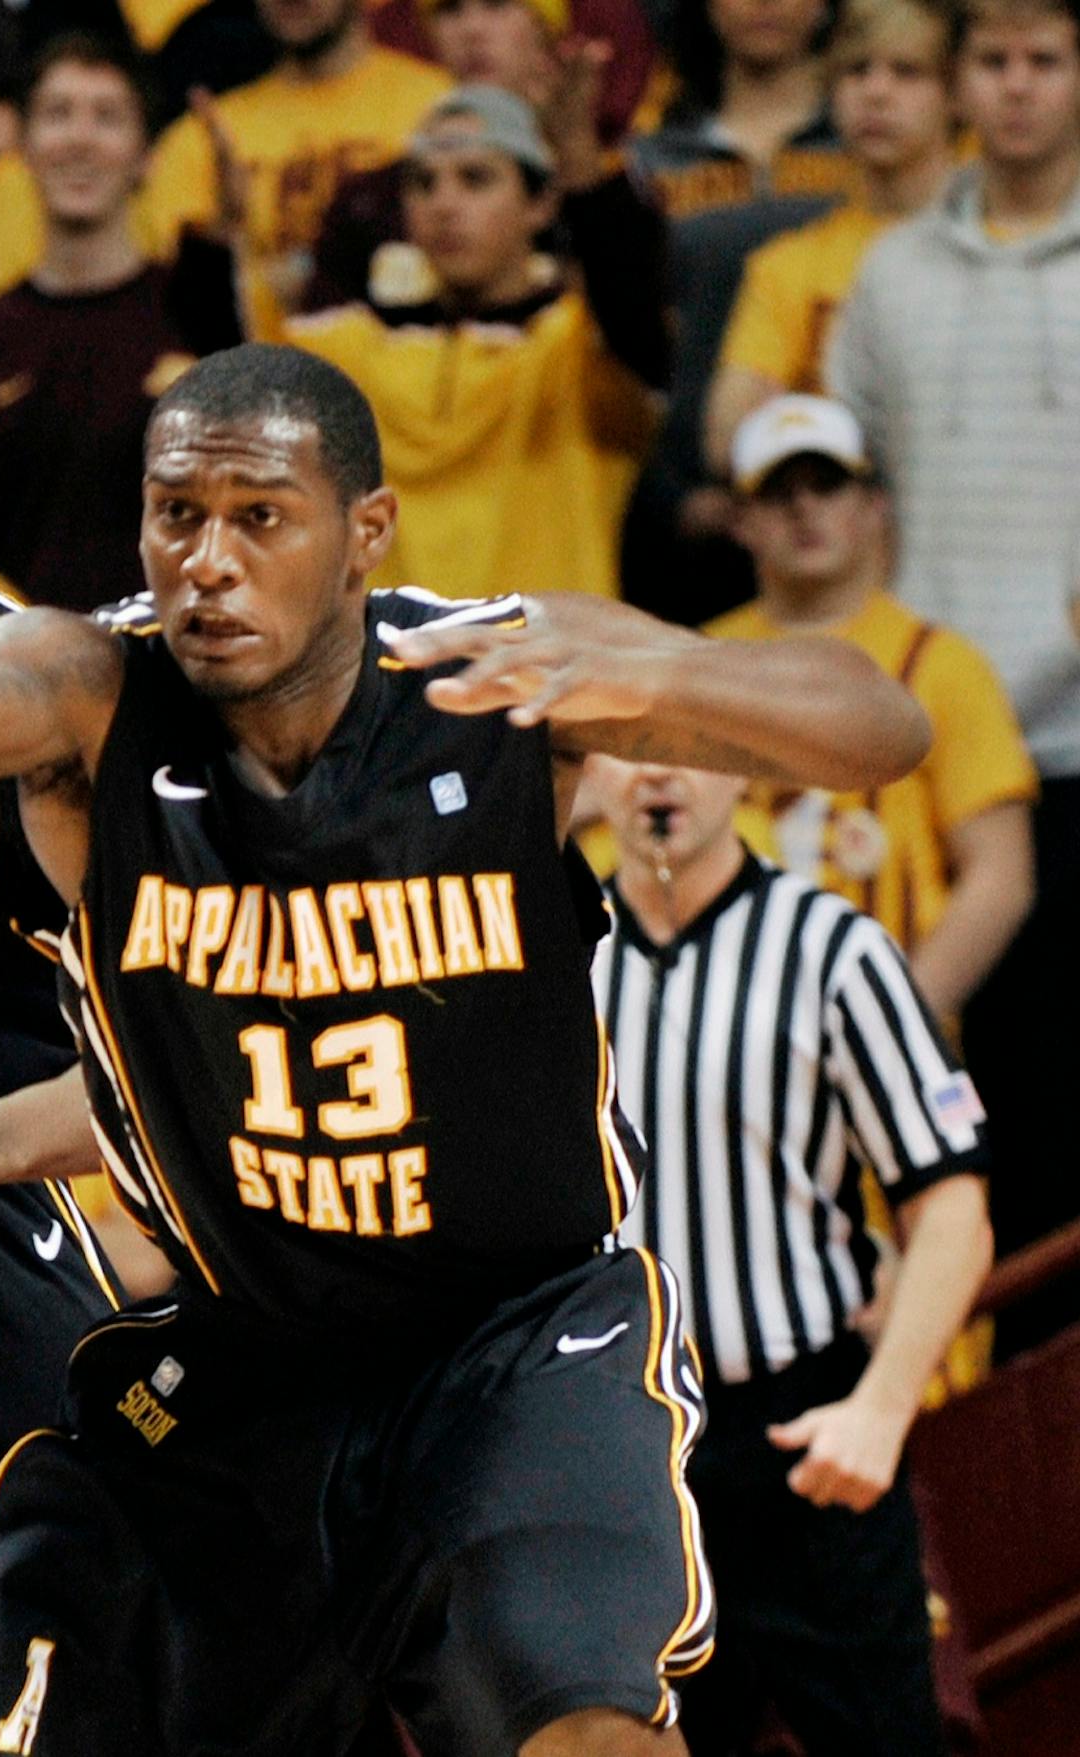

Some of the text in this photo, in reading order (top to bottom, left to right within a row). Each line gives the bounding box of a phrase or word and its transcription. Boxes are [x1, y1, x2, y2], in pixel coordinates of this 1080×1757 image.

[120, 873, 524, 998] APPALACHIAN
[238, 1012, 414, 1140] 13
[229, 1135, 432, 1238] STATE
[116, 1379, 178, 1447] SOCON
